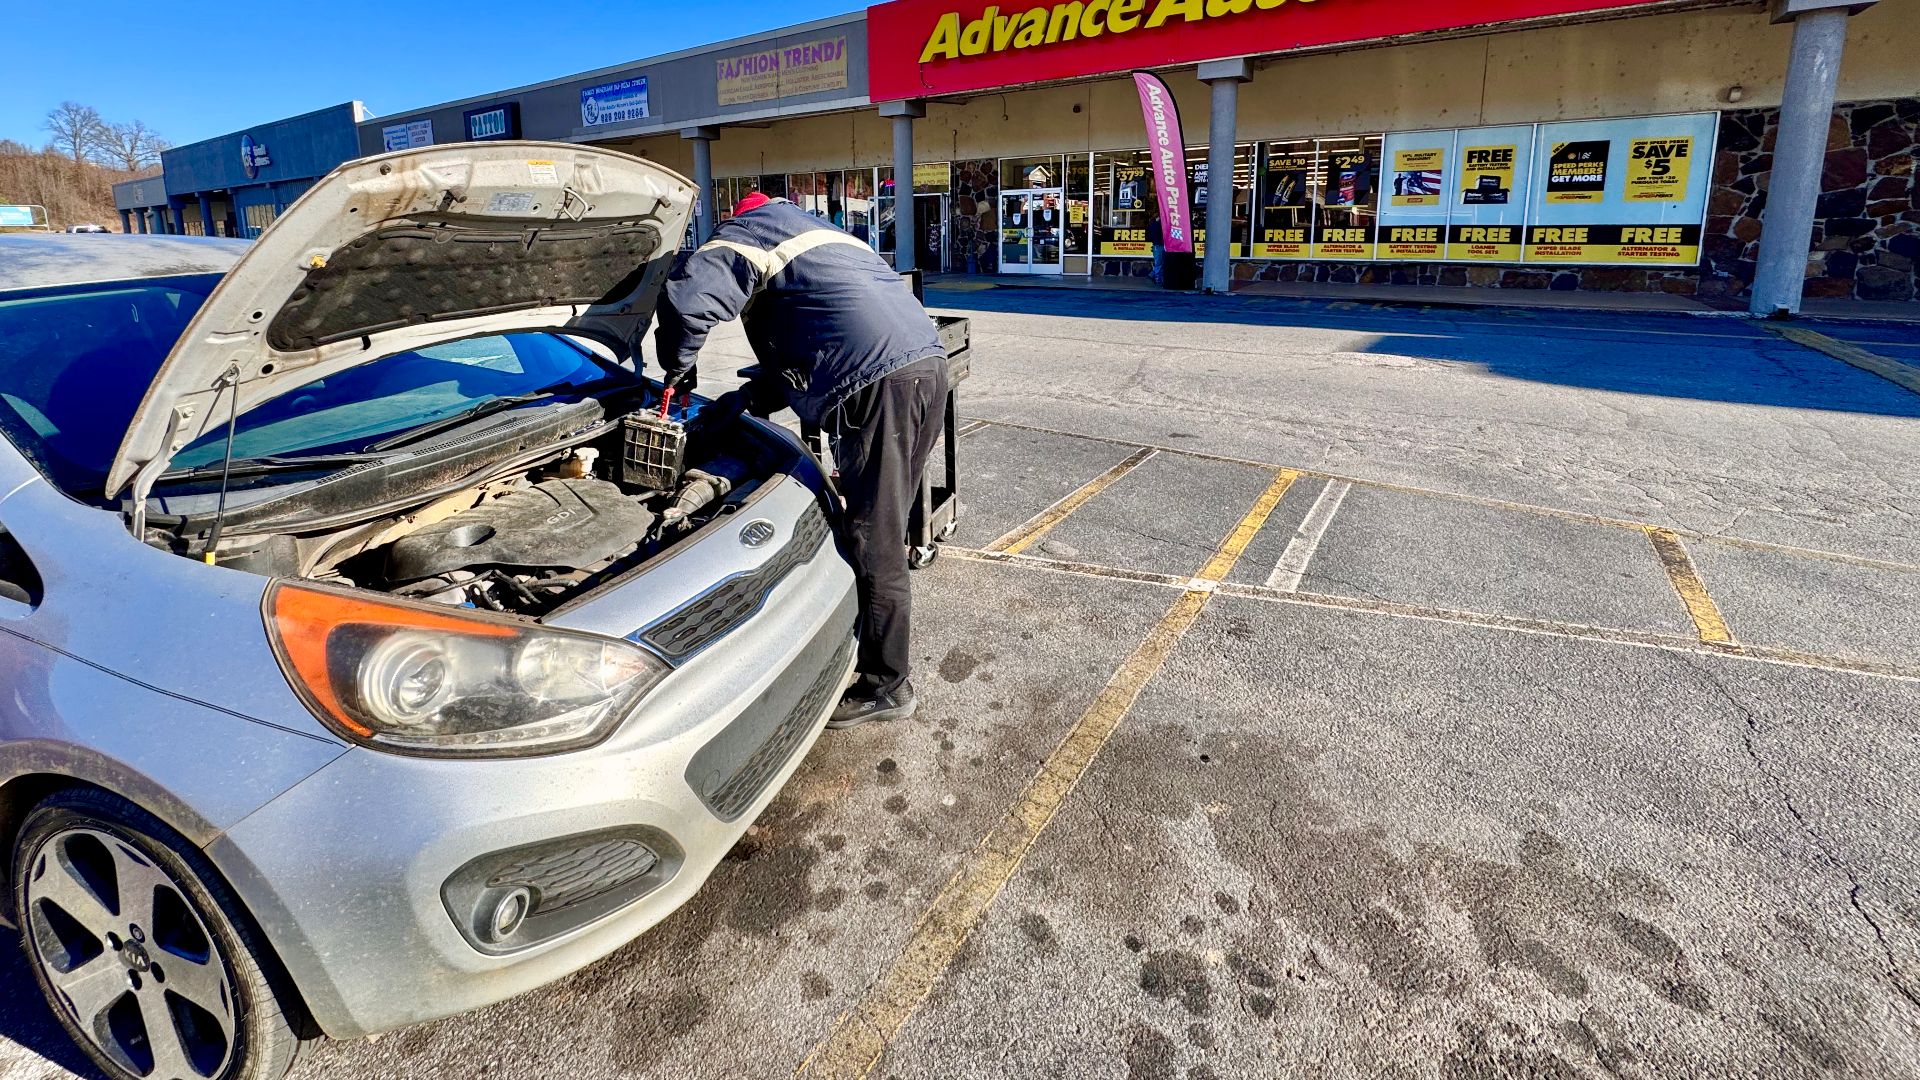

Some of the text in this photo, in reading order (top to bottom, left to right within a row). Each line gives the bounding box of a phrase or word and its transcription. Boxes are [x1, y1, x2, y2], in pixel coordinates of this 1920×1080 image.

[917, 0, 1145, 64] Advance
[719, 39, 845, 80] FASHION TRENDS
[472, 109, 505, 136] TATTOO
[1147, 83, 1180, 226] Advance Auto Parts
[1466, 148, 1513, 163] FREE
[1632, 144, 1689, 159] SAVE
[1269, 159, 1291, 167] SAVE
[1644, 159, 1671, 175] $5
[1113, 229, 1146, 241] FREE
[1193, 230, 1205, 241] FR
[1264, 229, 1304, 242] FREE
[1322, 228, 1365, 242] FREE
[1390, 228, 1438, 241] FREE
[1460, 228, 1511, 242] FREE
[1532, 228, 1589, 243] FREE
[1620, 228, 1682, 243] FREE
[546, 508, 576, 525] GDI
[744, 523, 773, 545] KIA
[124, 948, 146, 966] KIA
